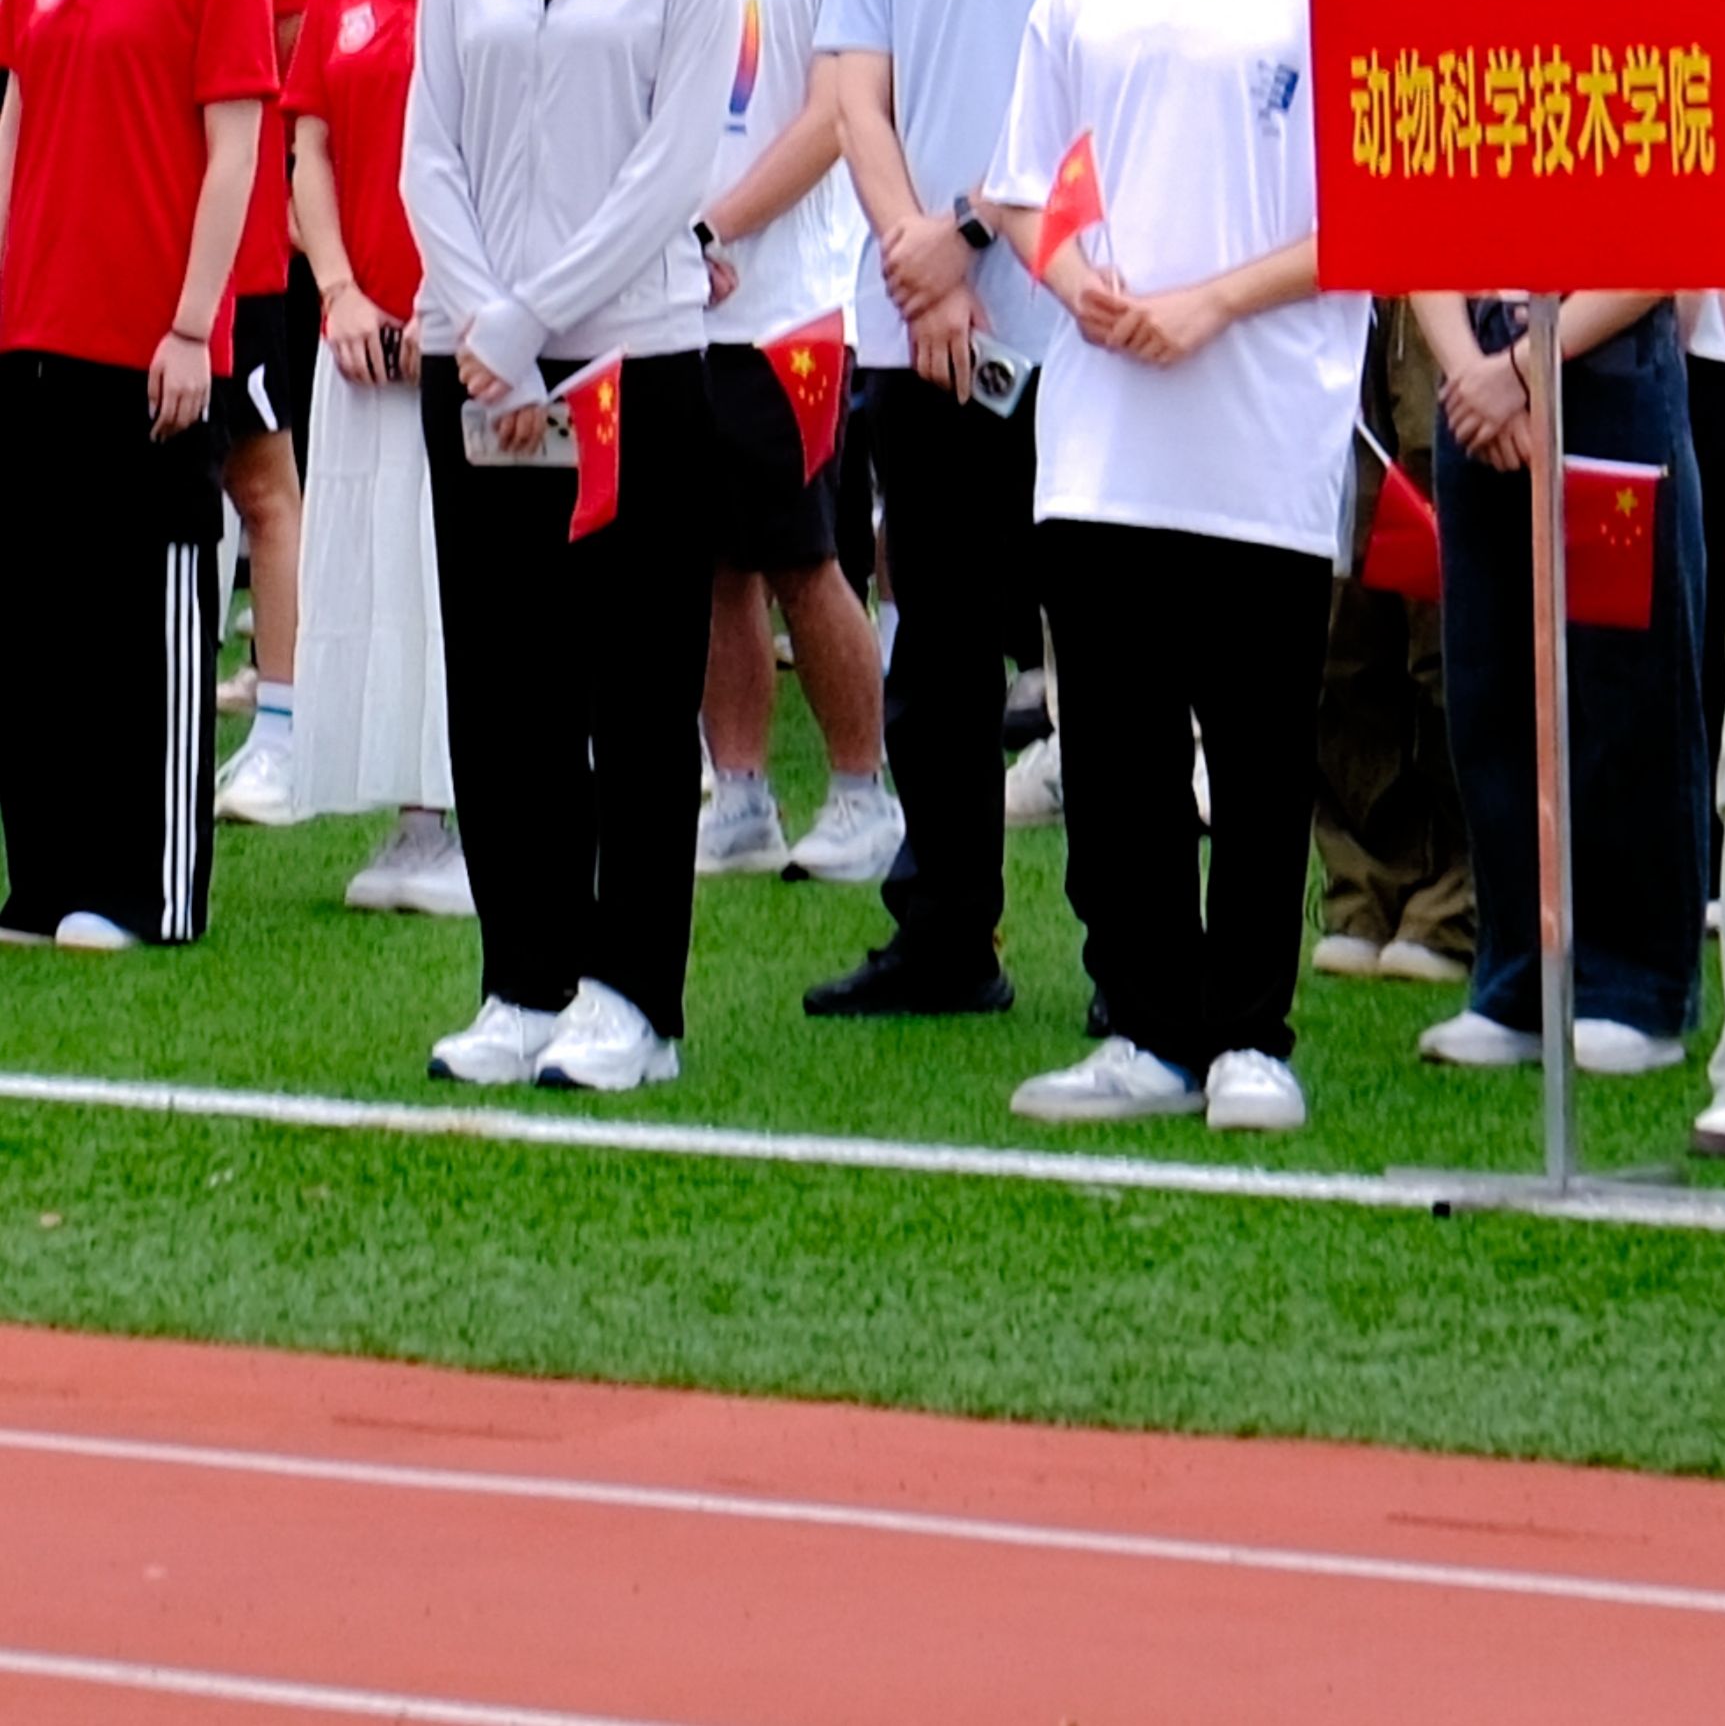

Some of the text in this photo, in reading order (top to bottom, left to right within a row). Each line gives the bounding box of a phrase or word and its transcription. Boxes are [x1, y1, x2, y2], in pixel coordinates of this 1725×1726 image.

[1350, 42, 1716, 178] 动物科学技术学院
